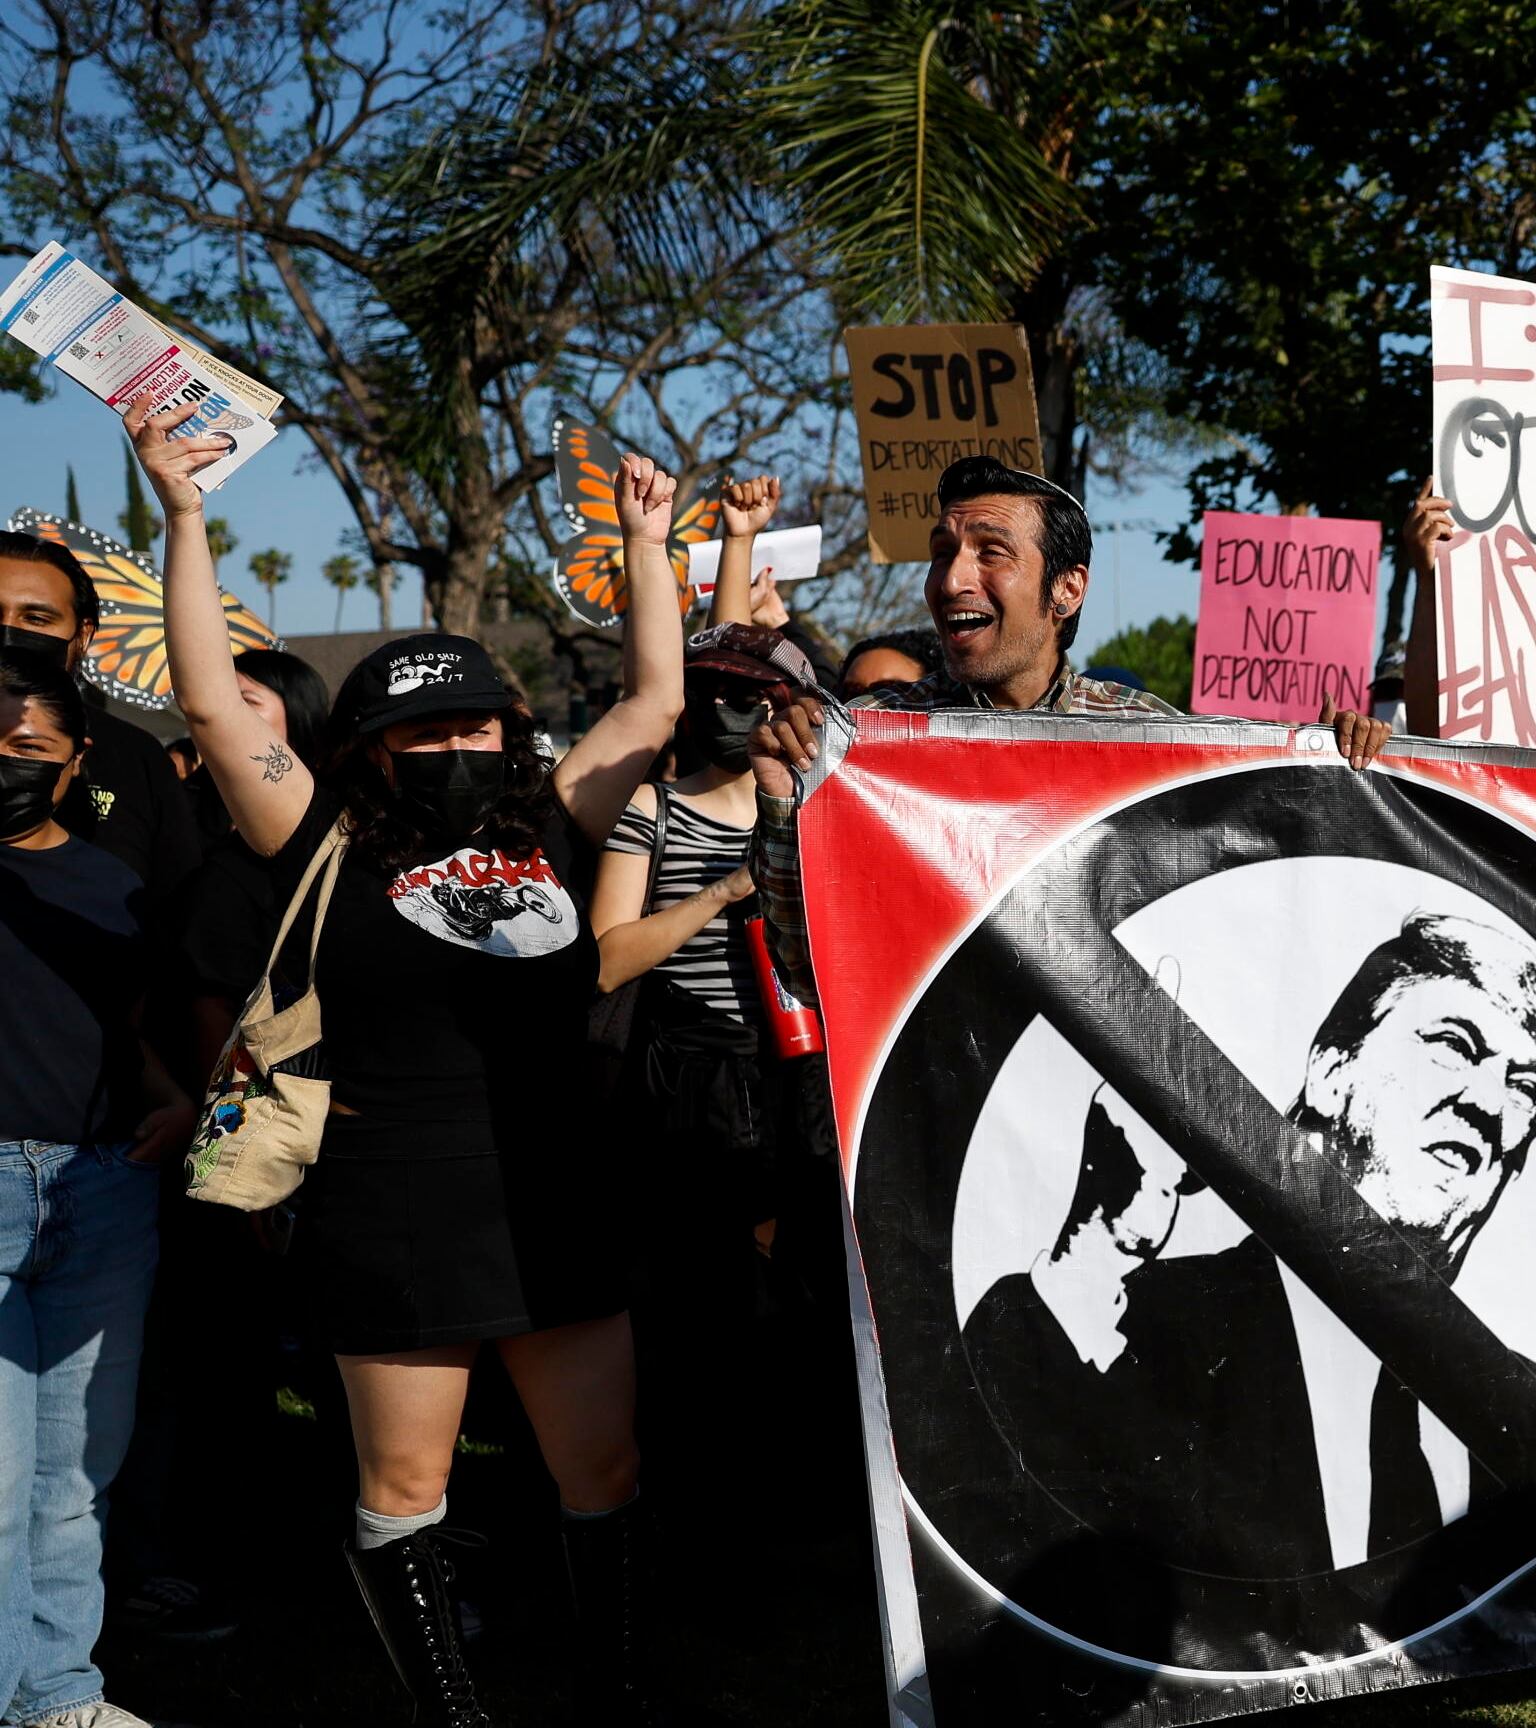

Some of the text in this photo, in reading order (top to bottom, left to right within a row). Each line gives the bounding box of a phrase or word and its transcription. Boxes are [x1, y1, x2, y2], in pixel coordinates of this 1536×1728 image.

[181, 378, 211, 402] NO
[870, 348, 1016, 427] STOP
[200, 391, 231, 419] NO
[870, 437, 1034, 471] DEPORTATIONS
[878, 491, 940, 519] #FUC
[1215, 538, 1373, 594] EDUCATION
[1243, 606, 1317, 655] NOT
[389, 653, 462, 669] SAME OLD SHIT
[426, 674, 463, 685] 24/7
[1201, 654, 1364, 710] DEPORTATION
